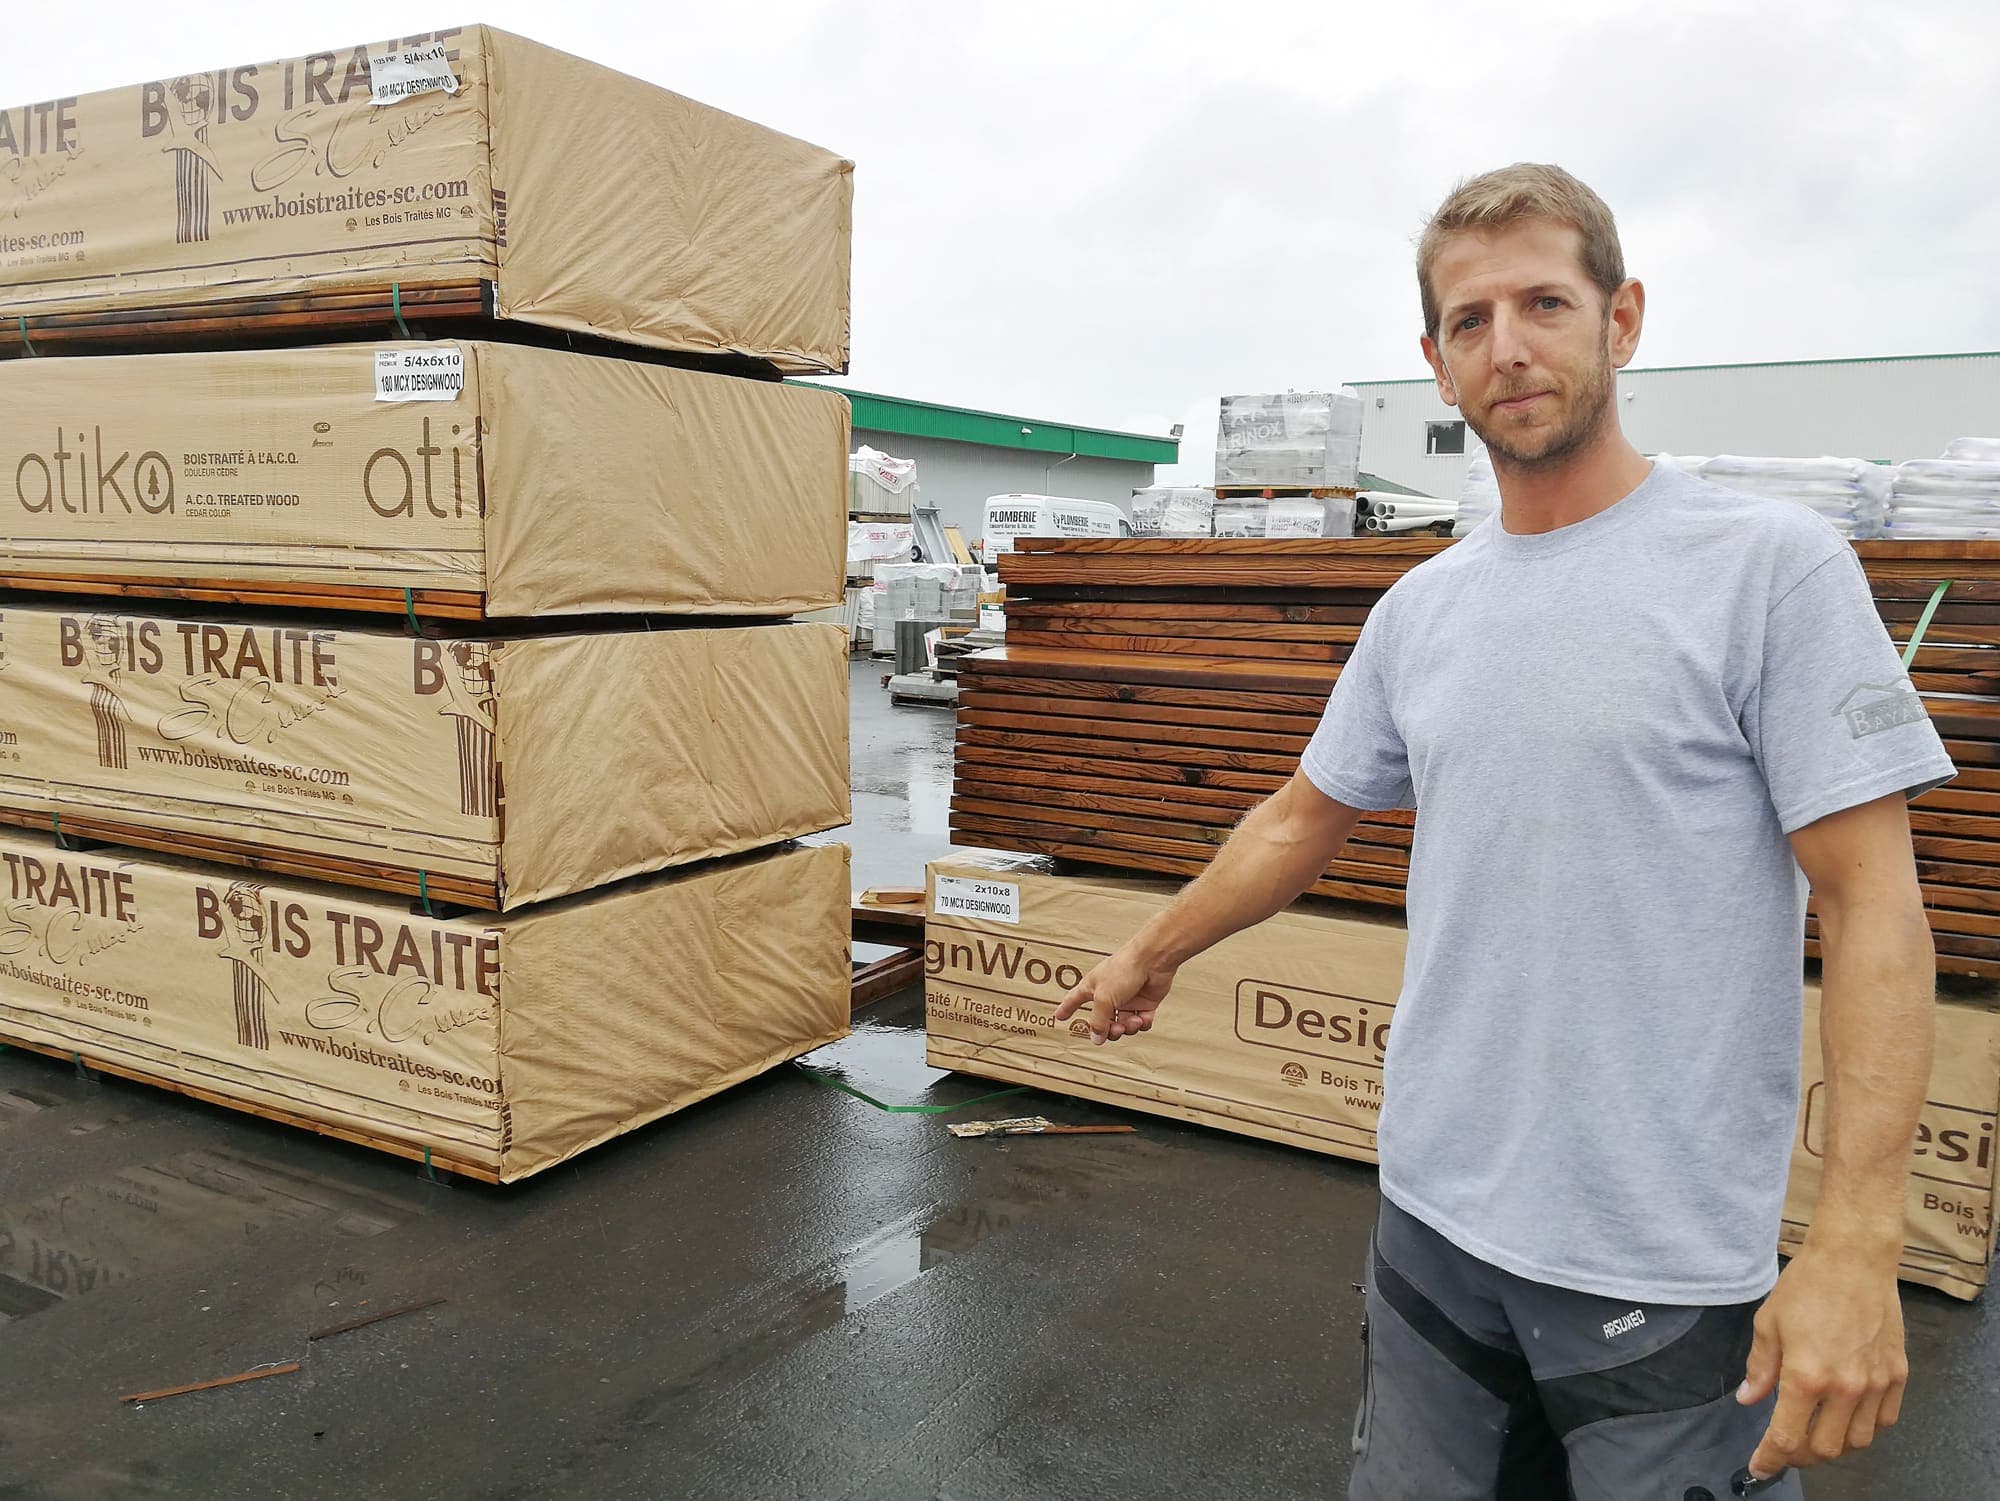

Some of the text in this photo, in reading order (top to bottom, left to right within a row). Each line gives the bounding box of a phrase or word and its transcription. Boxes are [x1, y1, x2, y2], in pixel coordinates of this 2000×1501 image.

[222, 179, 469, 226] www.boistraites-sc.com
[365, 207, 451, 227] Les Bois Traités MG
[404, 355, 460, 367] 5/4x6x10
[381, 373, 460, 392] 180 MCX DESIGNWOOD
[1231, 421, 1282, 448] RINOX
[183, 453, 207, 465] BOIS
[208, 450, 245, 465] TRAITÉ
[247, 449, 256, 465] À
[16, 425, 174, 514] atika
[184, 468, 216, 477] COULEUR
[185, 494, 300, 506] A.C.Q. TREATED WOOD
[185, 508, 231, 518] CEDAR COLOR
[989, 510, 1037, 523] PLOMBERIE
[1060, 514, 1088, 528] PLOMBERIE
[137, 746, 350, 787] www.boistraites-sc.com
[262, 782, 276, 793] Les
[278, 784, 295, 796] Bois
[322, 791, 336, 801] MG
[974, 884, 1011, 897] 2x10x8
[940, 896, 1011, 915] 70 MCX DESIGNWOOD
[926, 939, 1083, 991] gnWoo
[963, 996, 1013, 1019] Treated
[1016, 1007, 1056, 1029] Wood
[1320, 1070, 1359, 1091] Bois
[417, 1083, 433, 1095] Les
[434, 1087, 453, 1100] Bois
[484, 1100, 500, 1111] MG
[1344, 1095, 1381, 1111] www
[1923, 1192, 1975, 1219] Bois
[1603, 1309, 1646, 1339] ARSUXEO
